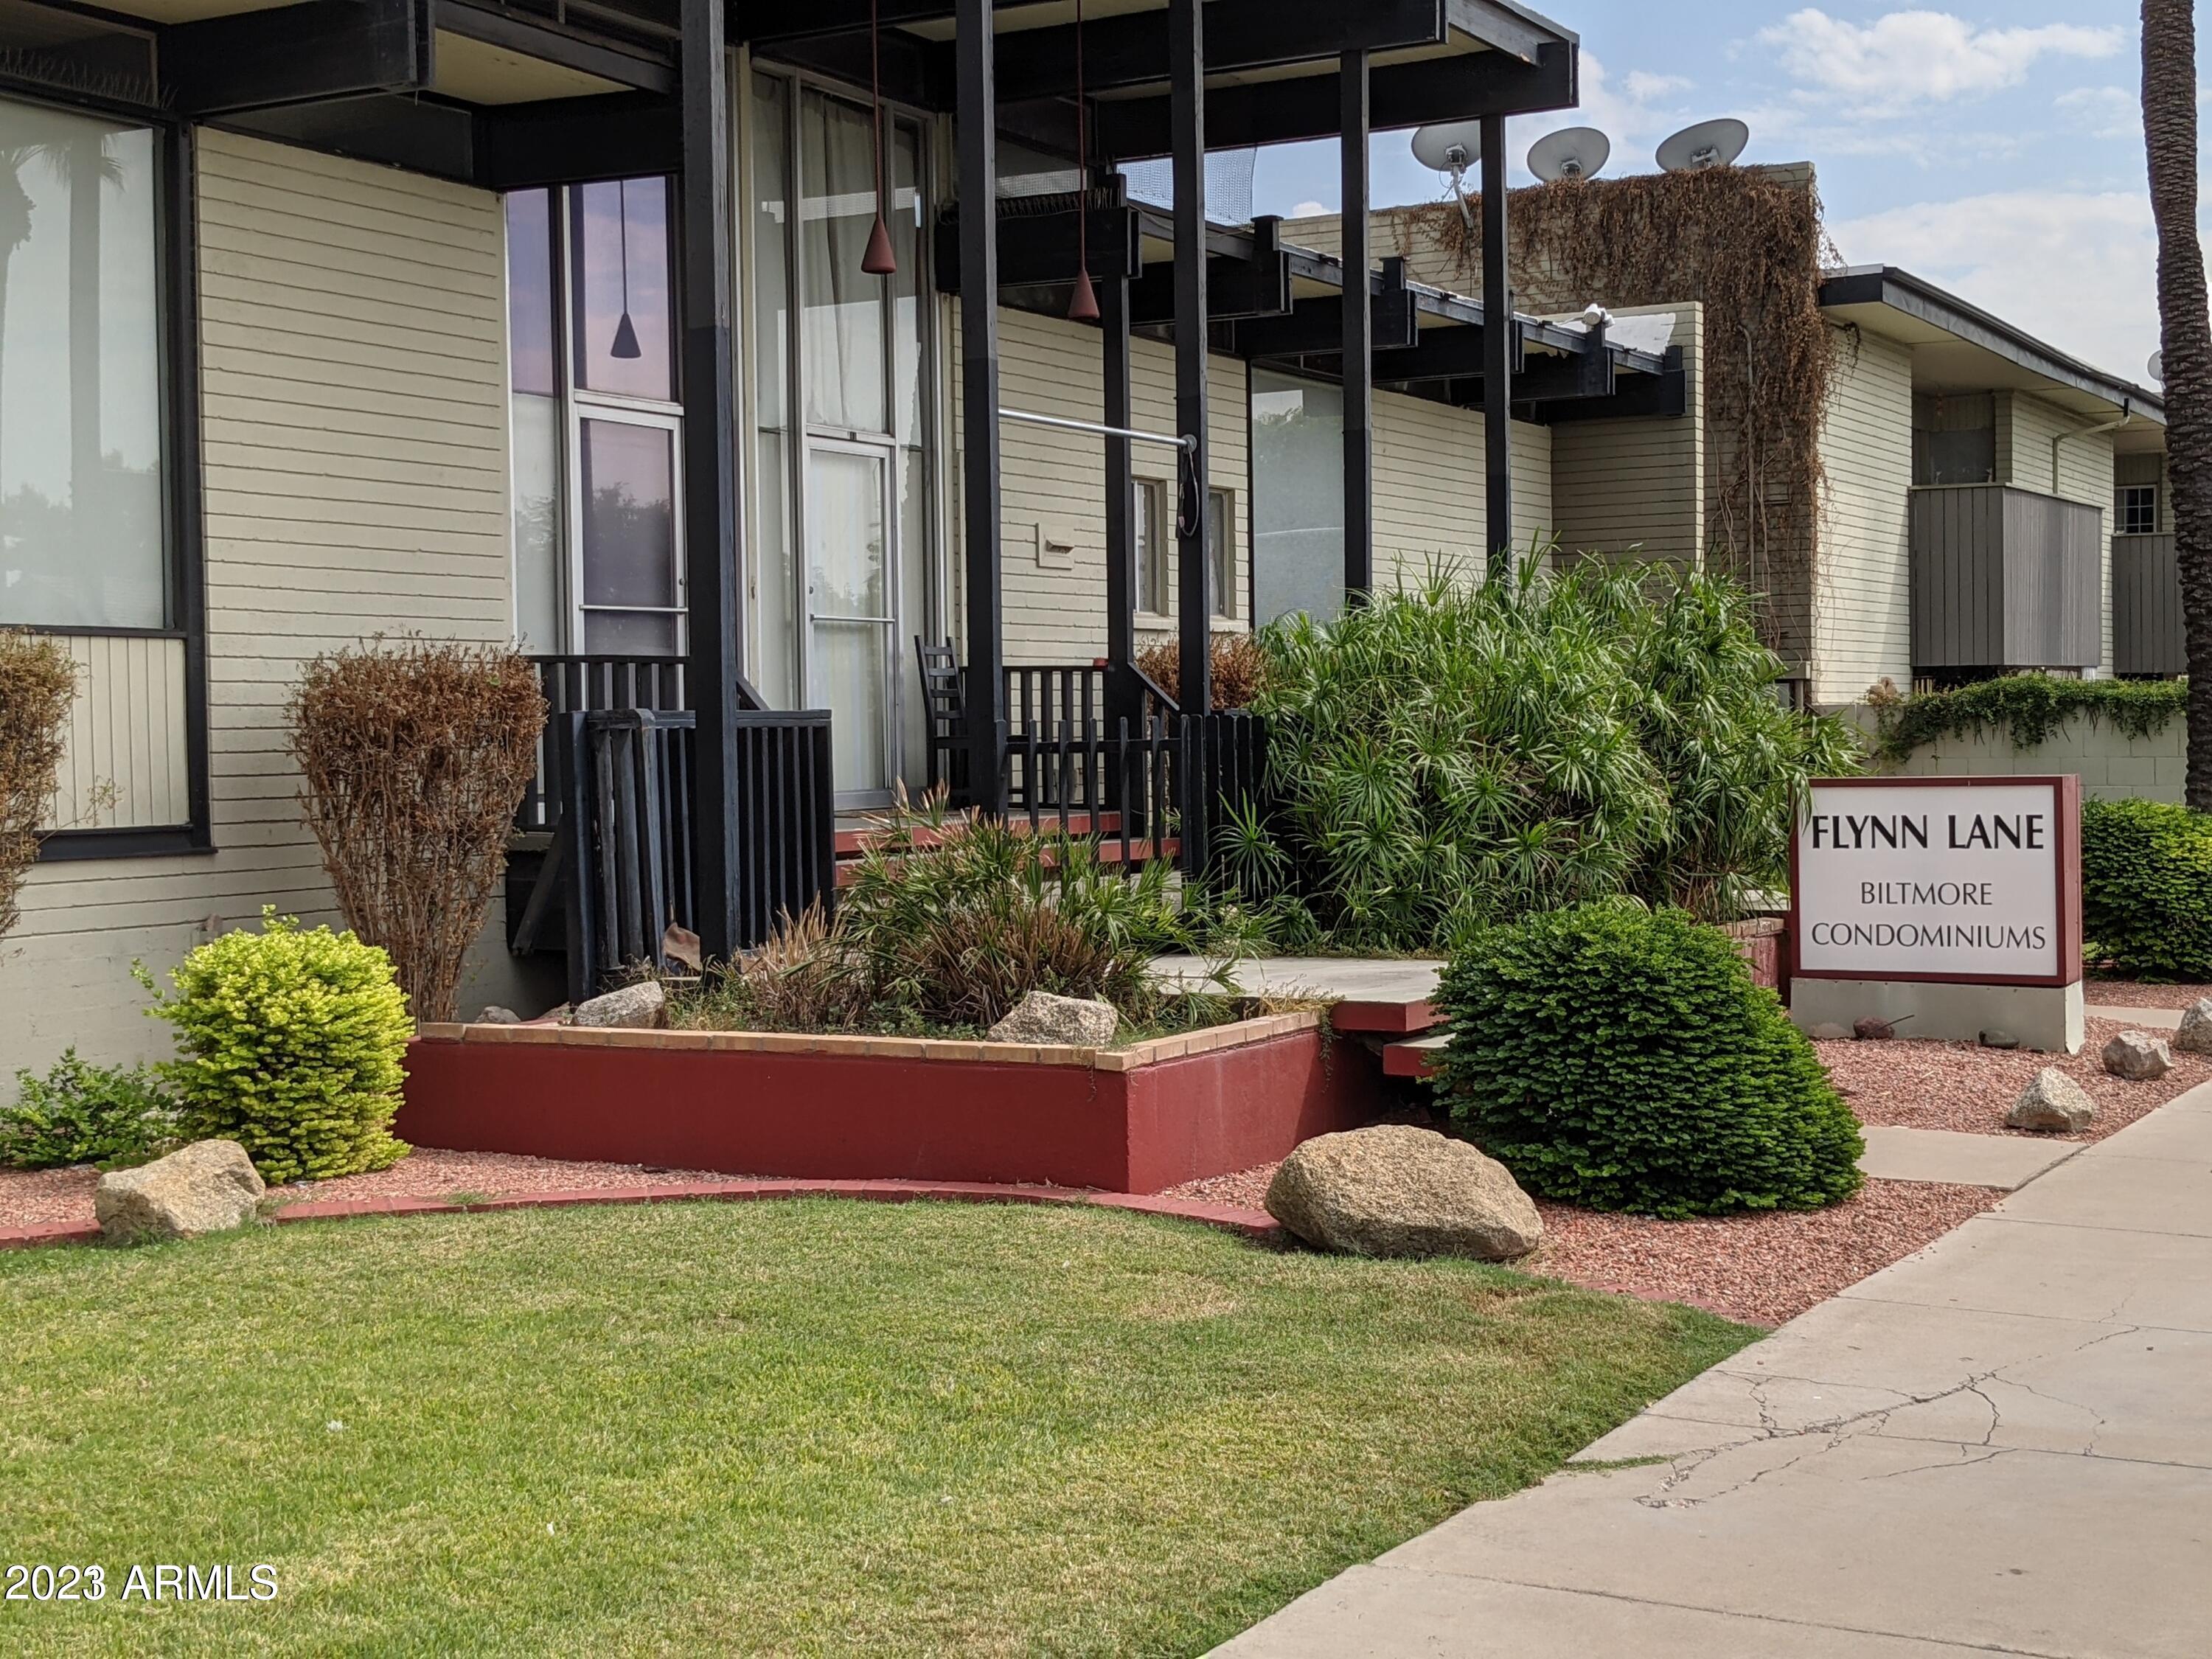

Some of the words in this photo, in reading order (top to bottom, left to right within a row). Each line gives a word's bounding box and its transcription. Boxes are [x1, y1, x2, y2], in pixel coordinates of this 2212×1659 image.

[1812, 815, 1928, 849] FLYNN
[1948, 814, 2044, 849] LANE
[1860, 882, 1993, 905] BILTMORE
[1812, 922, 2046, 950] CONDOMINIUMS
